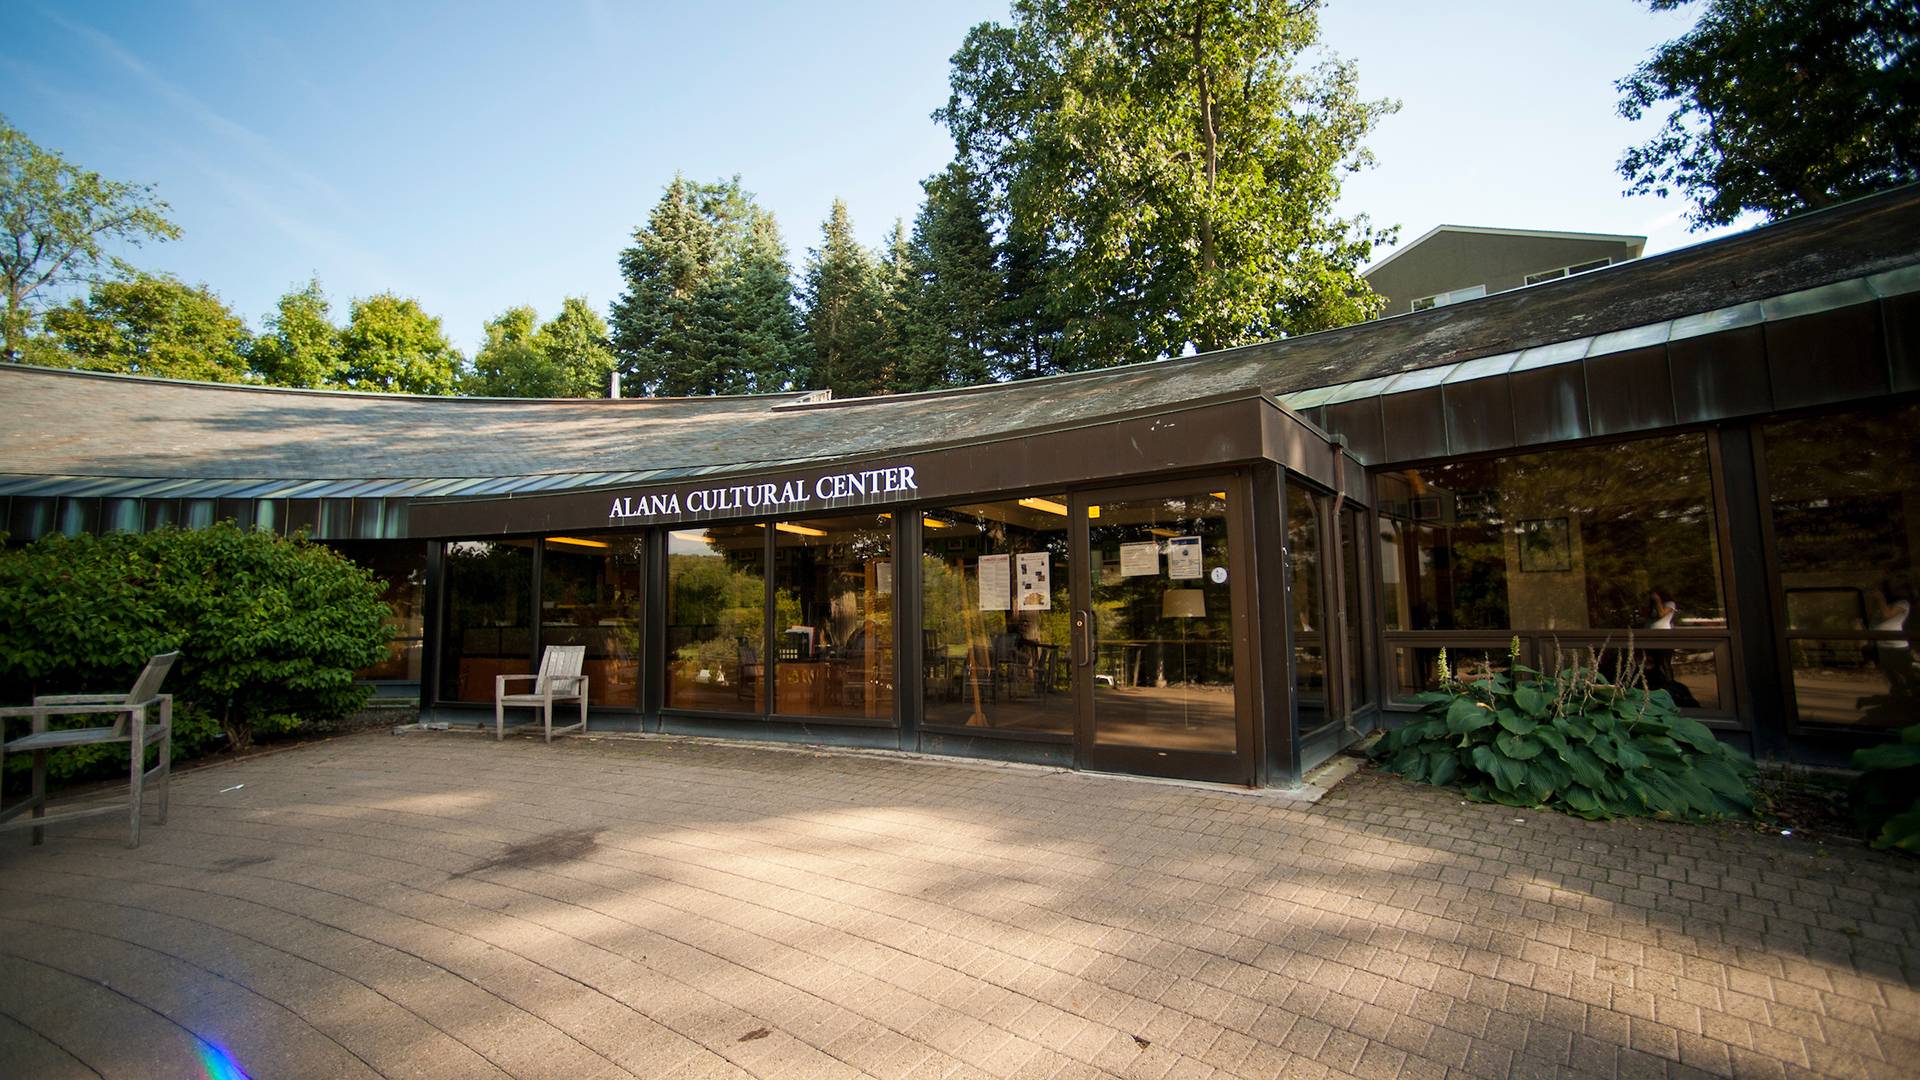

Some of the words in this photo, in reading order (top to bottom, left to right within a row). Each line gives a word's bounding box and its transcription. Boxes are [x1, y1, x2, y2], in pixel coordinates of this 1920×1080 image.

[609, 493, 681, 518] ALANA
[686, 480, 810, 513] CULTURAL
[815, 465, 918, 500] CENTER
